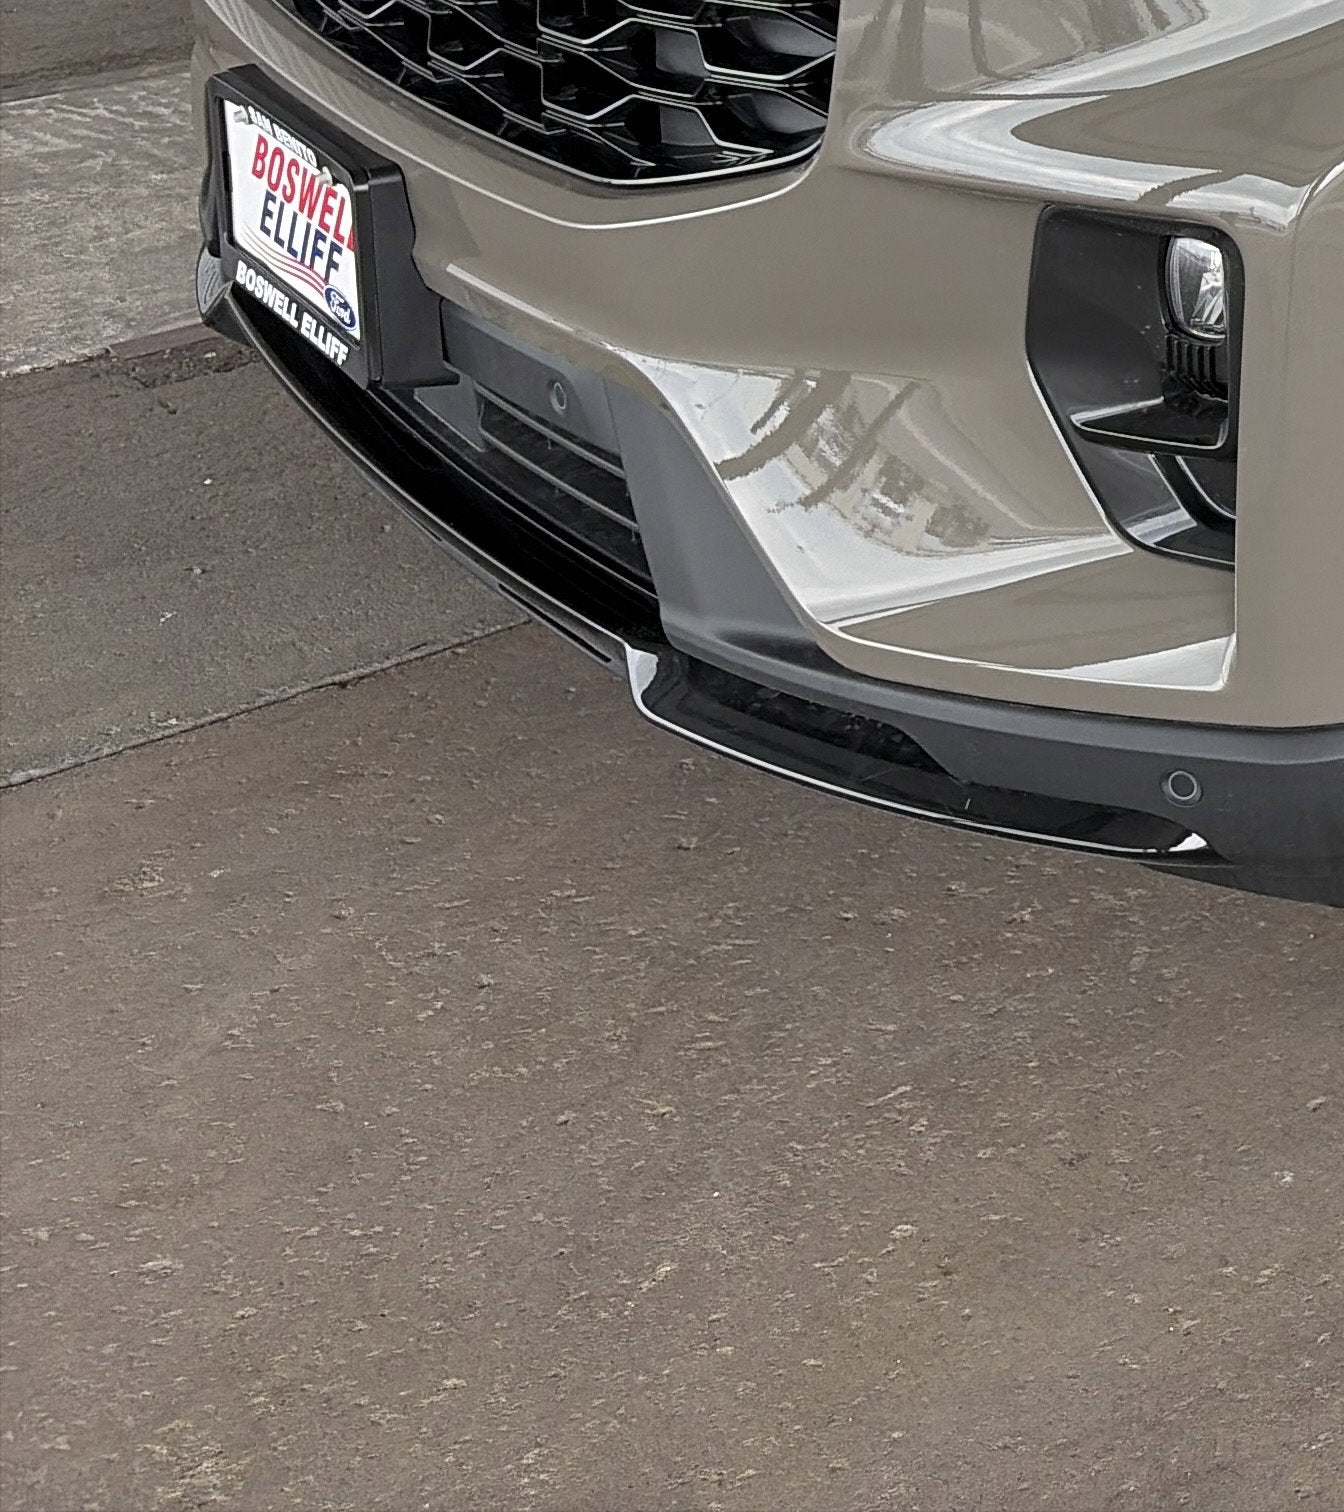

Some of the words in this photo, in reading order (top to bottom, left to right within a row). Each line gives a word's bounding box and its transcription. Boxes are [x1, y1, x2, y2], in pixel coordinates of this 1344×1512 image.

[259, 189, 343, 284] ELLIFF
[235, 259, 299, 329] BOSWELL
[300, 311, 349, 366] ELLIFF
[329, 290, 351, 325] Ford
